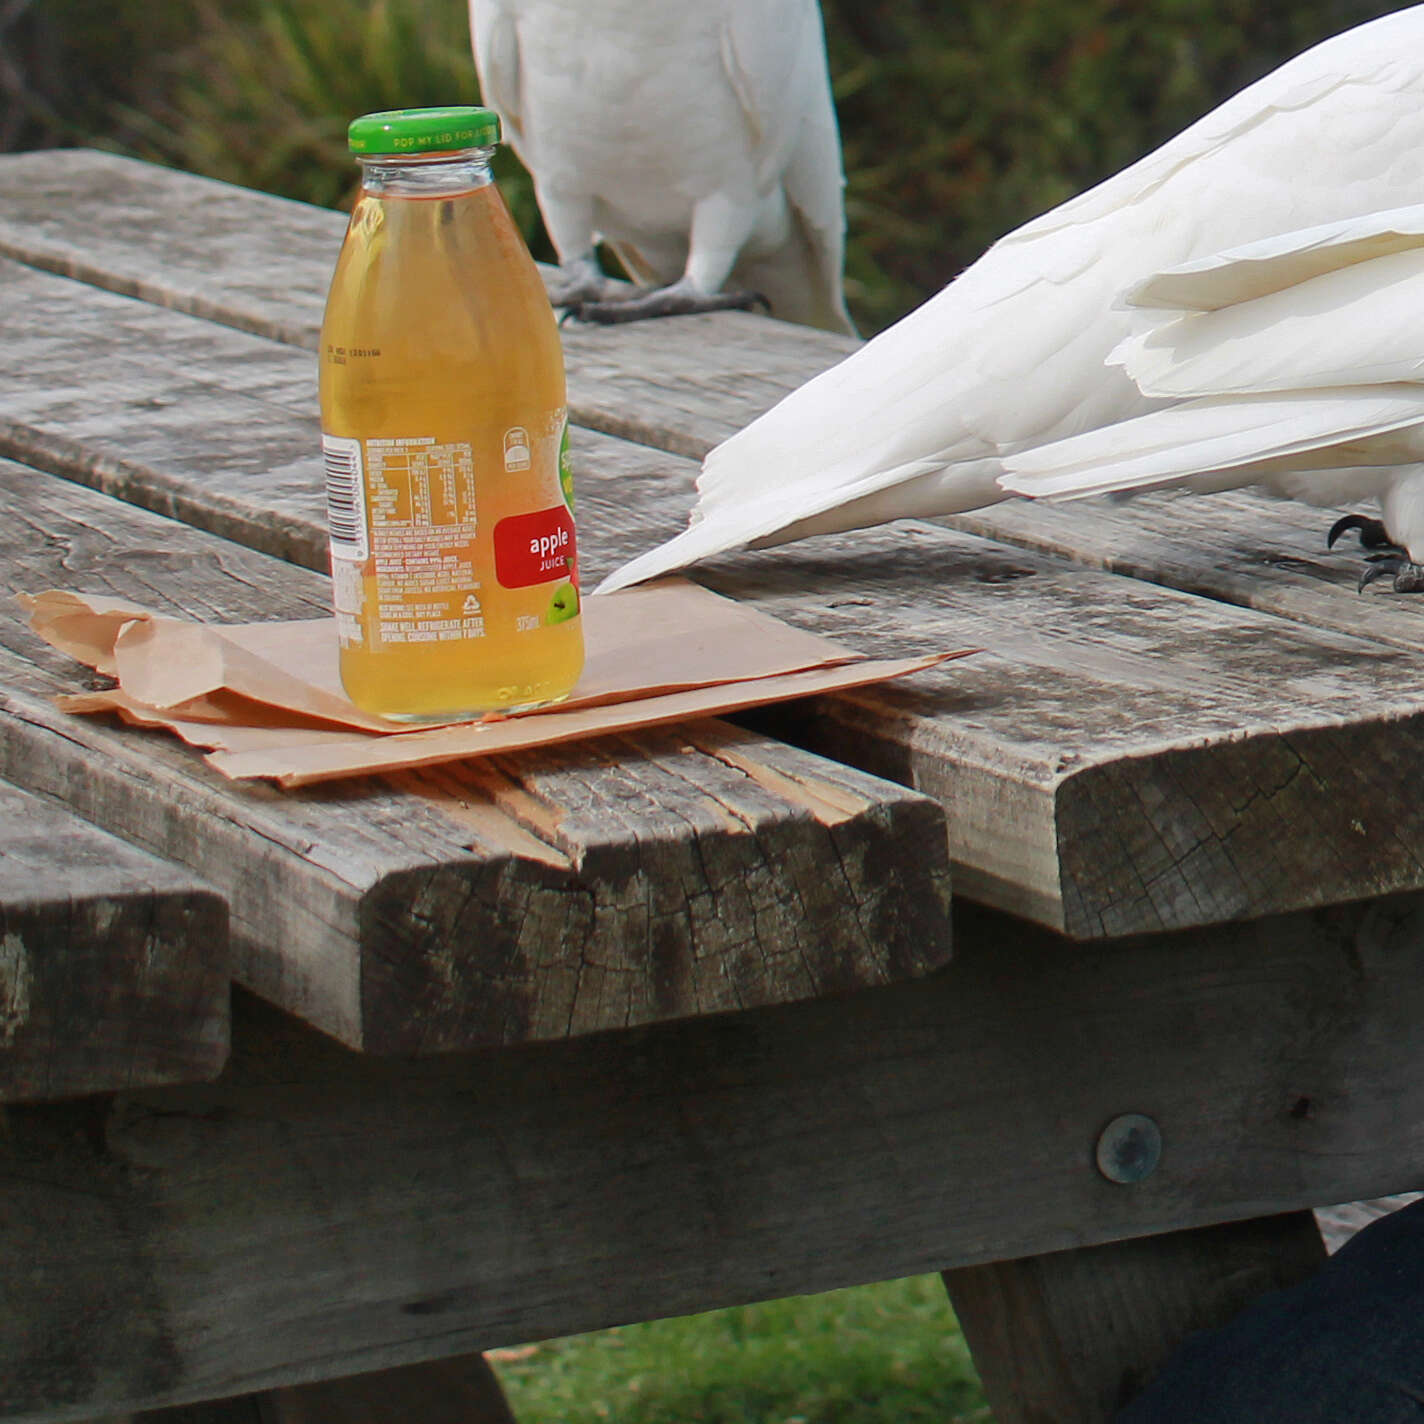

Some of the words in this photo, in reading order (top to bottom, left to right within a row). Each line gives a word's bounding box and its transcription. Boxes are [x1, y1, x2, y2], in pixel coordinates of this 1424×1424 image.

[393, 137, 414, 149] POP
[418, 136, 432, 145] MY
[435, 133, 452, 145] LID
[530, 526, 569, 558] apple
[540, 555, 565, 572] JUICE
